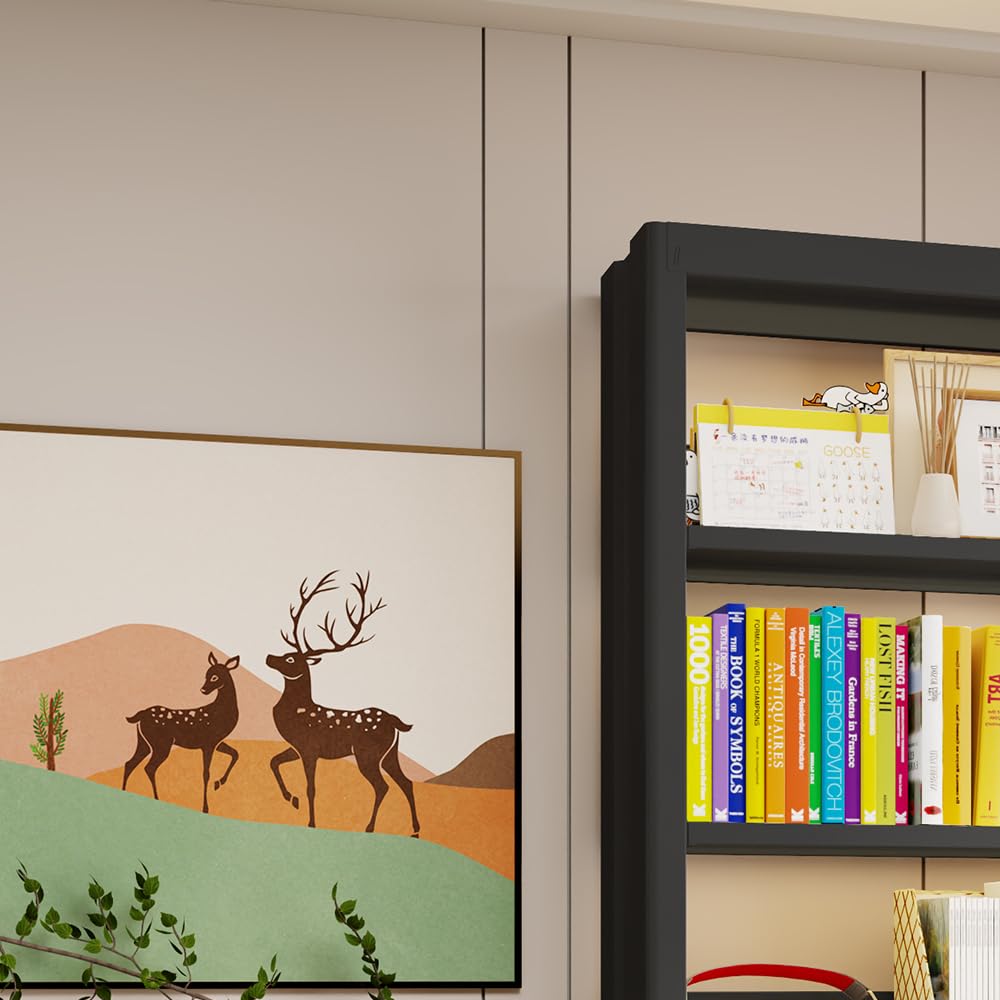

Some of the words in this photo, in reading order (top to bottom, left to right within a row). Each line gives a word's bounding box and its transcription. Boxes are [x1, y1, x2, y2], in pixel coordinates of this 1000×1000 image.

[823, 444, 873, 459] GOOSE
[689, 623, 710, 685] 1000
[730, 636, 738, 653] THE
[826, 611, 842, 685] ALEXEY
[879, 623, 892, 669] LOST
[896, 634, 906, 685] MAKING
[730, 655, 743, 700] BOOK
[848, 677, 858, 719] Gardens
[879, 674, 892, 712] FISH
[896, 687, 906, 701] IT
[730, 702, 738, 713] OF
[771, 662, 784, 768] ANTIQUAIRES
[848, 720, 858, 731] in
[730, 716, 743, 794] SYMBOLS
[826, 690, 842, 811] BRODOVITCH
[848, 733, 858, 768] France
